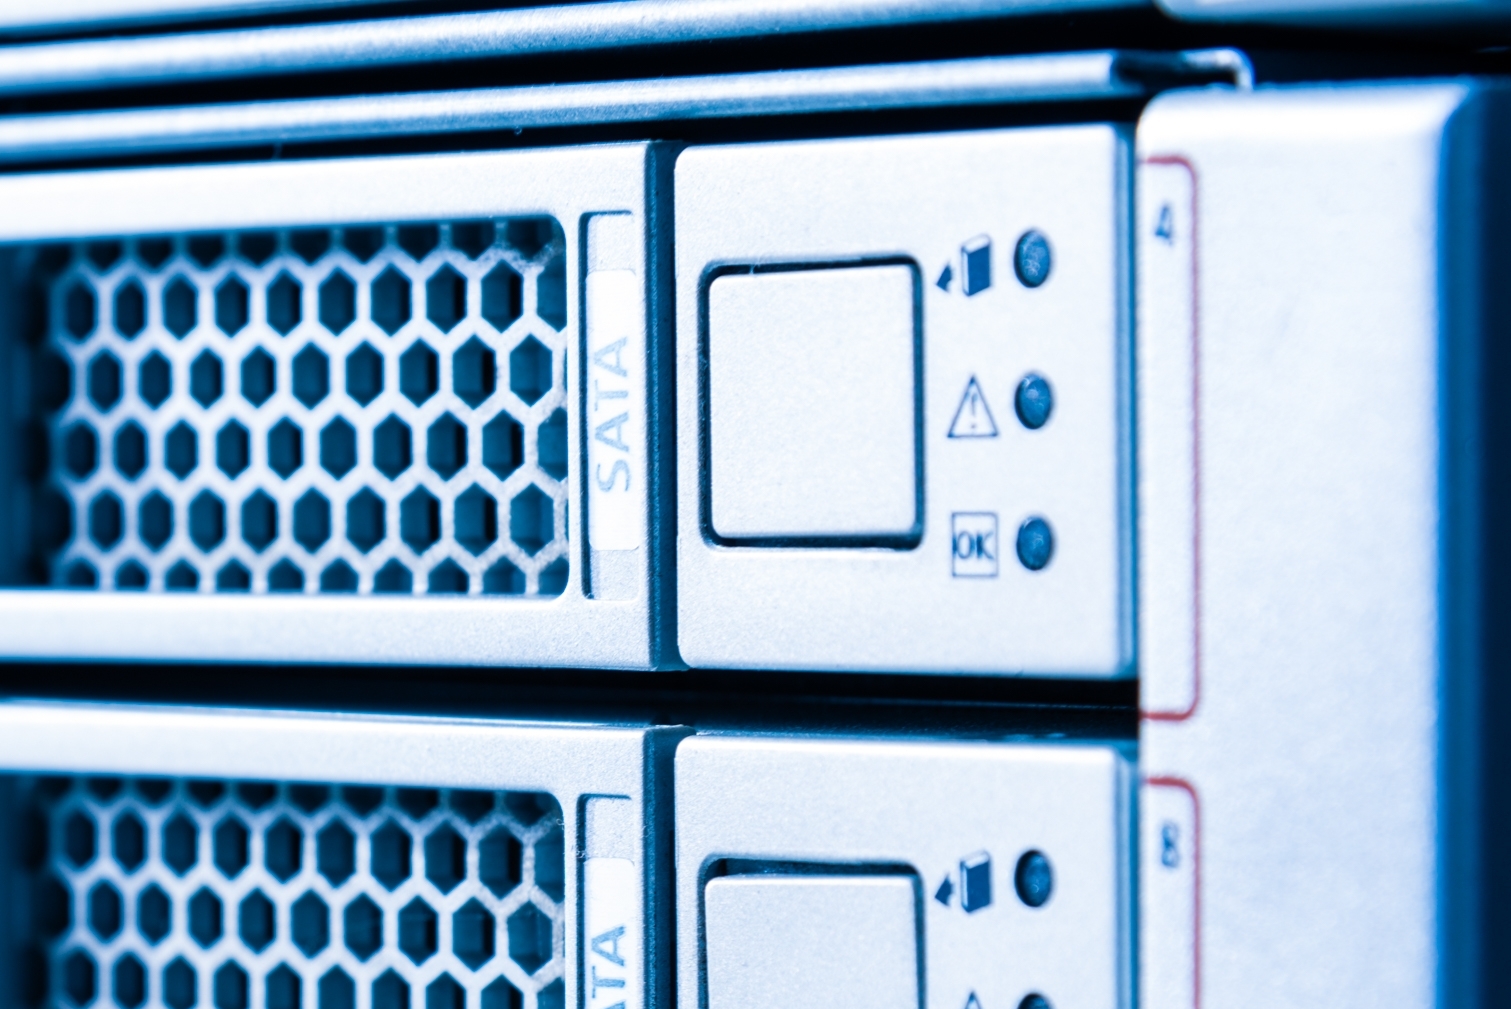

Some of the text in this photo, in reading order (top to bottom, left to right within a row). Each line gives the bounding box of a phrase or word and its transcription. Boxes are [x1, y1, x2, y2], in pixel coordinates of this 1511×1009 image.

[1153, 203, 1175, 246] 4
[593, 335, 630, 494] SATA
[953, 531, 995, 560] OK
[1160, 821, 1180, 869] 8
